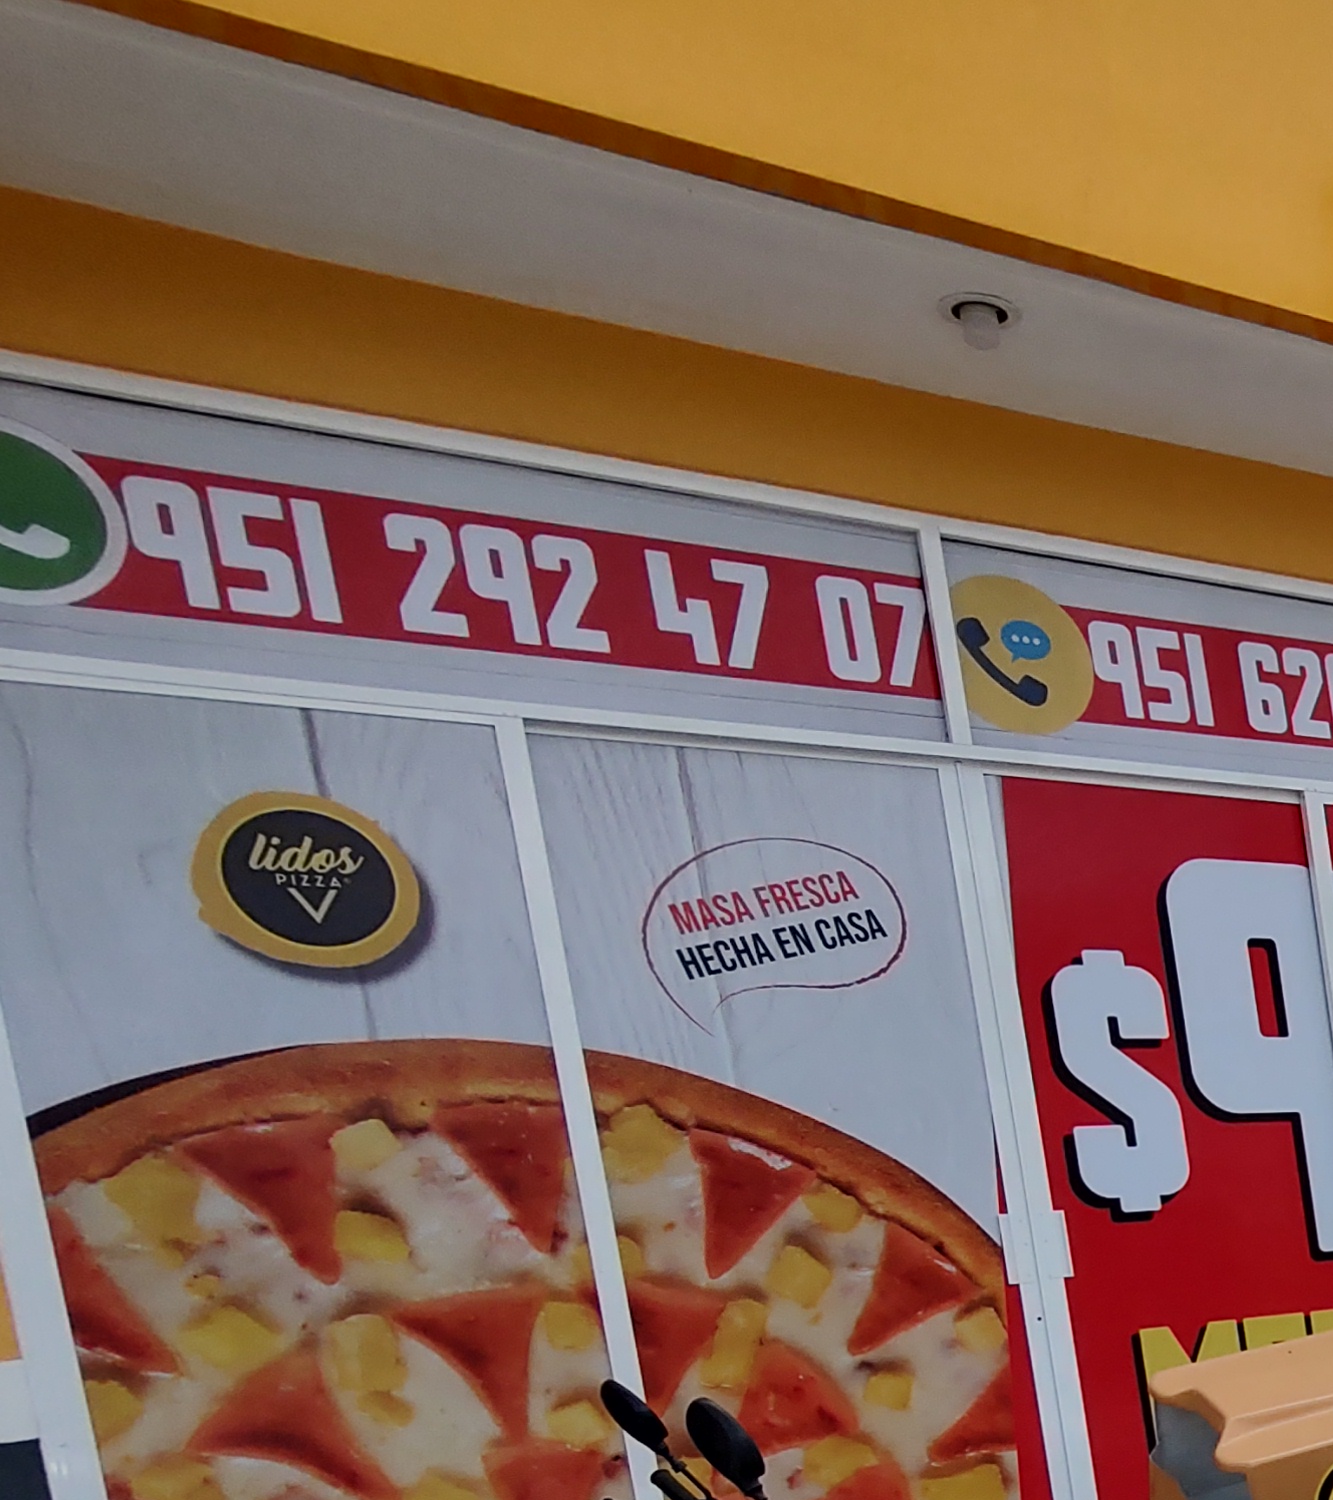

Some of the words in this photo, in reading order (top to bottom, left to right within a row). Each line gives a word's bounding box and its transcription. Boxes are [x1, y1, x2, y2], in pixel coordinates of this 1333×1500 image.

[120, 474, 343, 624] 951
[383, 511, 612, 654] 292
[645, 549, 770, 671] 47
[814, 574, 927, 688] 07
[1087, 619, 1216, 727] 951
[248, 832, 366, 875] lidos
[275, 873, 343, 889] PIZZA
[668, 891, 755, 935] MASA
[752, 870, 860, 918] FRESCA
[676, 932, 776, 980] HECHA
[772, 923, 816, 959] EN
[814, 908, 889, 950] CASA
